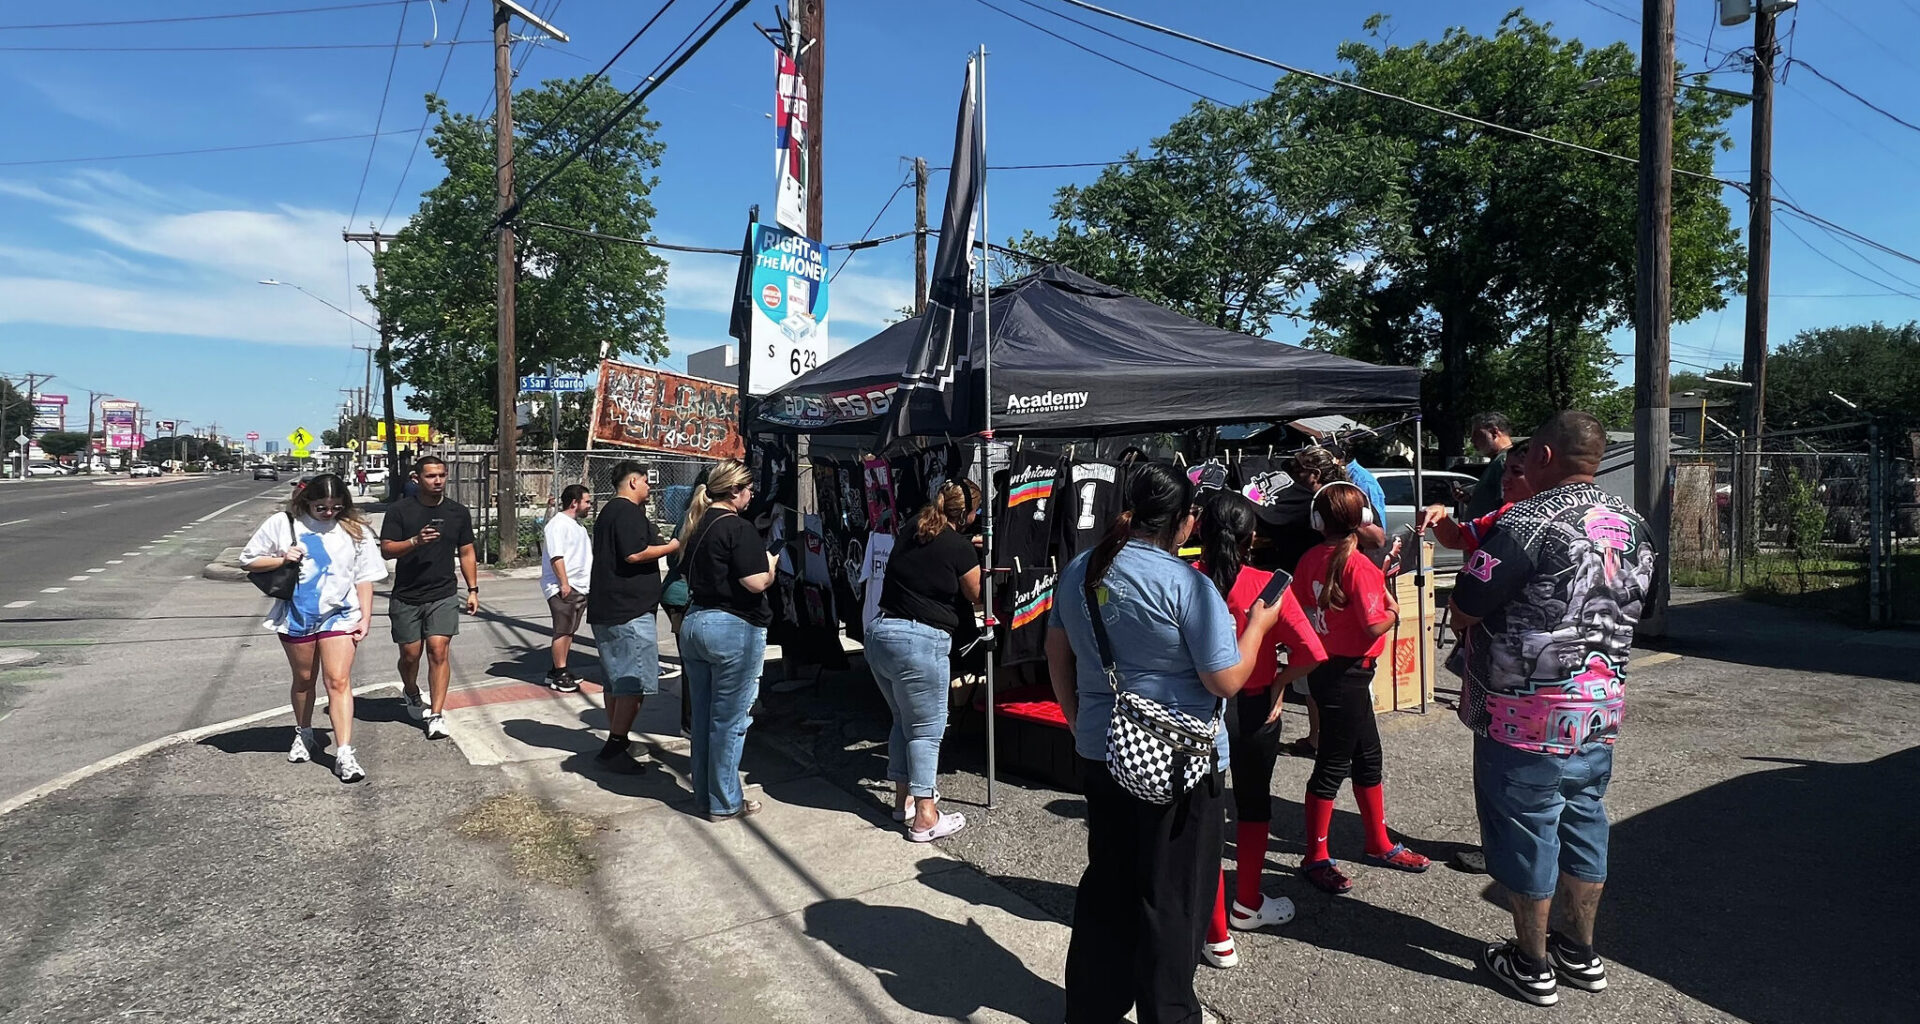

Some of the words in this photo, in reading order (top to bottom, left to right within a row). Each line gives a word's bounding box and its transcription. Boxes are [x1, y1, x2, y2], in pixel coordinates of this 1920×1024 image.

[764, 231, 811, 257] RIGHT
[810, 250, 822, 264] ON
[756, 253, 780, 270] THE
[780, 254, 828, 283] MONEY
[522, 378, 528, 388] S
[530, 378, 546, 388] San
[550, 378, 584, 388] Eduardo
[1006, 390, 1089, 410] Academy
[1077, 482, 1097, 530] 1
[1536, 493, 1578, 520] PURO
